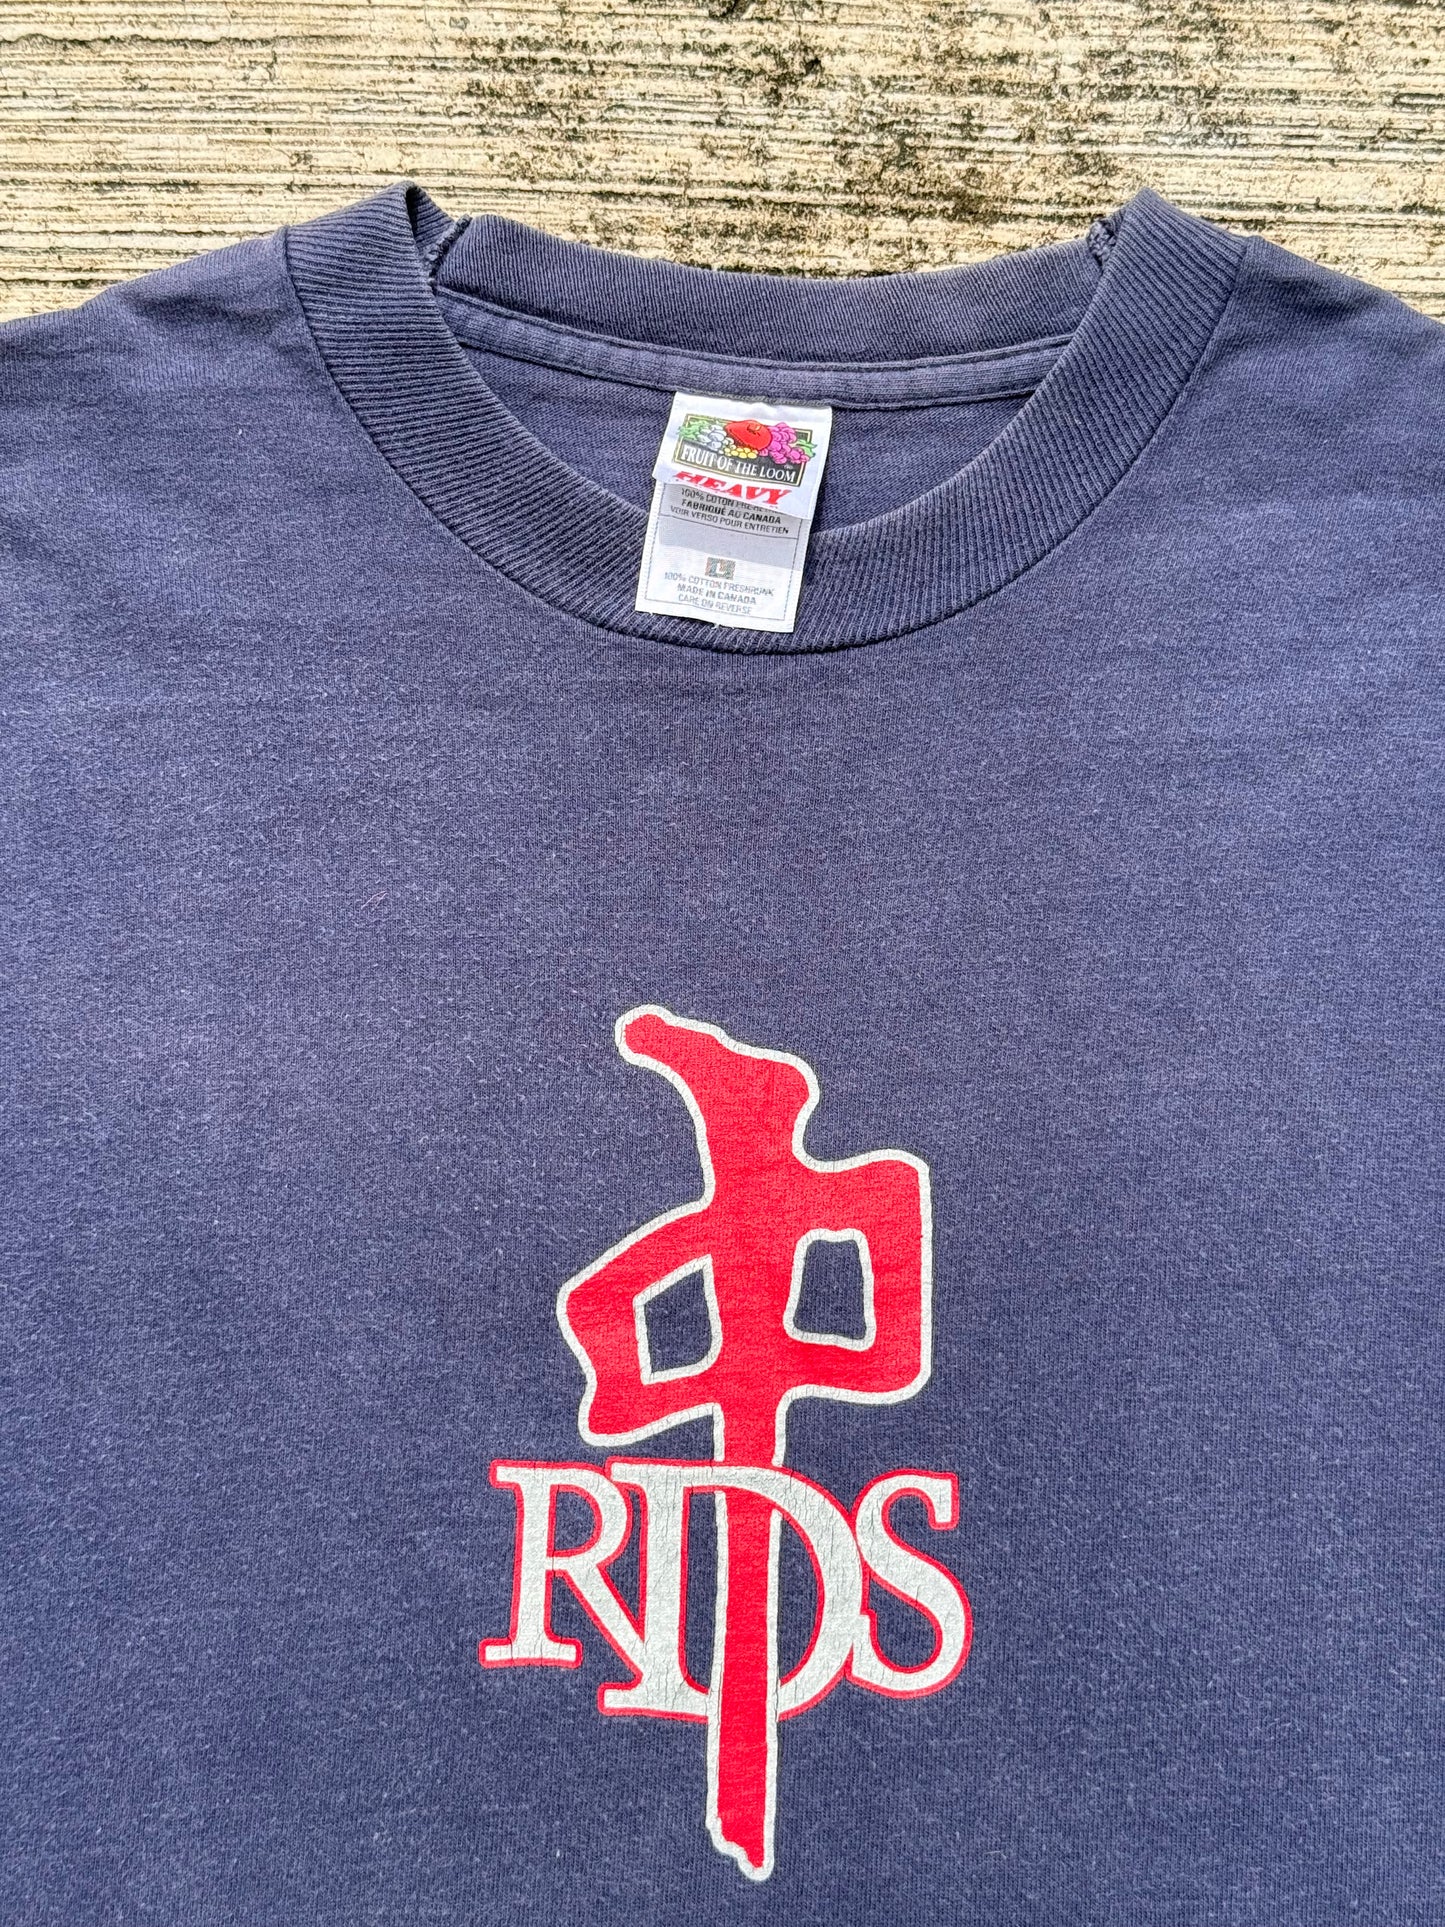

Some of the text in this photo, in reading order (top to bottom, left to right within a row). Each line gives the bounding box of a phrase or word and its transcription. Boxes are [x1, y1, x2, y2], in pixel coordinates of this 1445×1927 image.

[681, 444, 717, 468] FRUIT
[717, 455, 734, 471] OF
[735, 461, 757, 477] THE
[759, 465, 796, 483] LOOM
[673, 471, 792, 505] HEAVY
[682, 487, 704, 501] 100%
[670, 505, 789, 534] VOIR VERSO POUR ENTRETIEN
[682, 499, 781, 524] FABRIQUÉ AU CANADA
[664, 572, 686, 582] 100%
[688, 575, 722, 589] COTTON
[677, 583, 757, 605] MADE IN CANADA
[678, 594, 753, 615] CARE ON REVERSE
[478, 1456, 974, 1721] RDS
